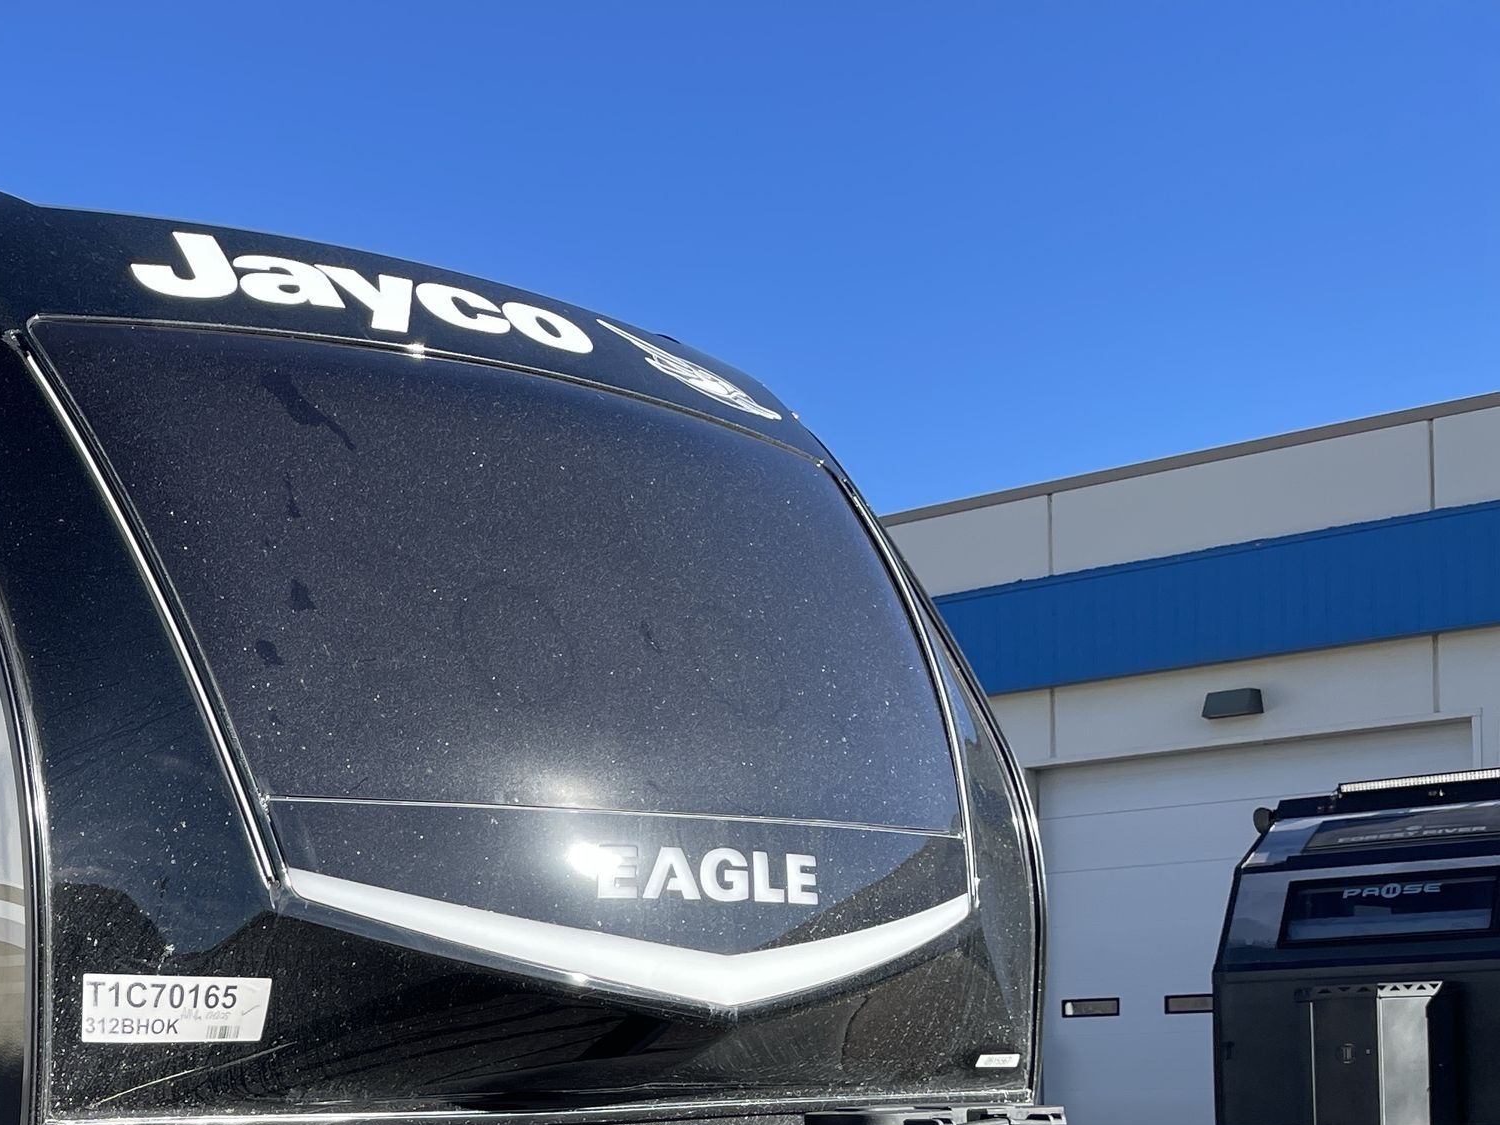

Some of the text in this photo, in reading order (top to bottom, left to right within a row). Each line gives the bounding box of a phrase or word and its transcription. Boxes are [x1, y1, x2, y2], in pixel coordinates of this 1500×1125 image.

[131, 231, 593, 353] Jayco
[1338, 826, 1487, 843] FOREST RIVER
[596, 844, 819, 905] EAGLE
[86, 981, 238, 1009] T1C70165
[85, 1018, 180, 1035] 312BHOK
